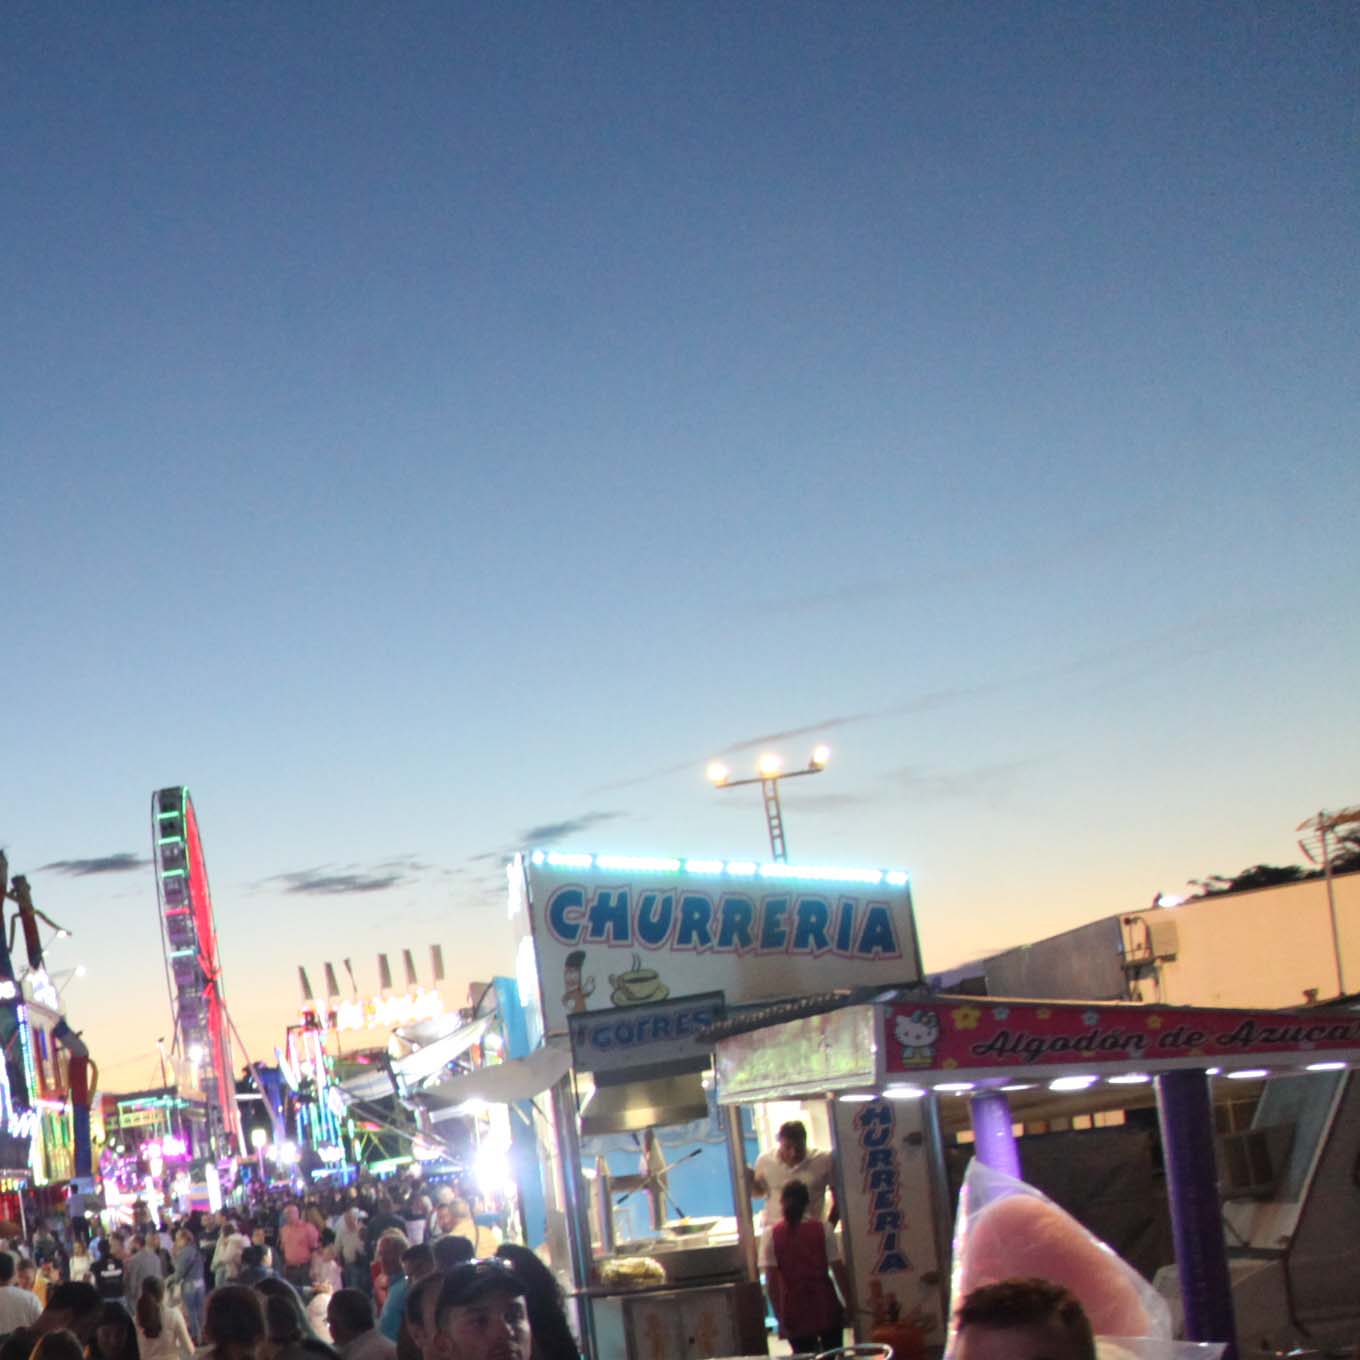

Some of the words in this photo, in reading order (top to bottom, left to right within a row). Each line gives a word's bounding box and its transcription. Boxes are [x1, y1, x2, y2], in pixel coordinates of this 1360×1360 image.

[547, 885, 902, 957] CHURRERIA
[591, 1009, 713, 1052] GOFRES
[972, 1027, 1148, 1063] Algodón
[1158, 1025, 1206, 1048] de
[854, 1097, 912, 1274] HURRERIA
